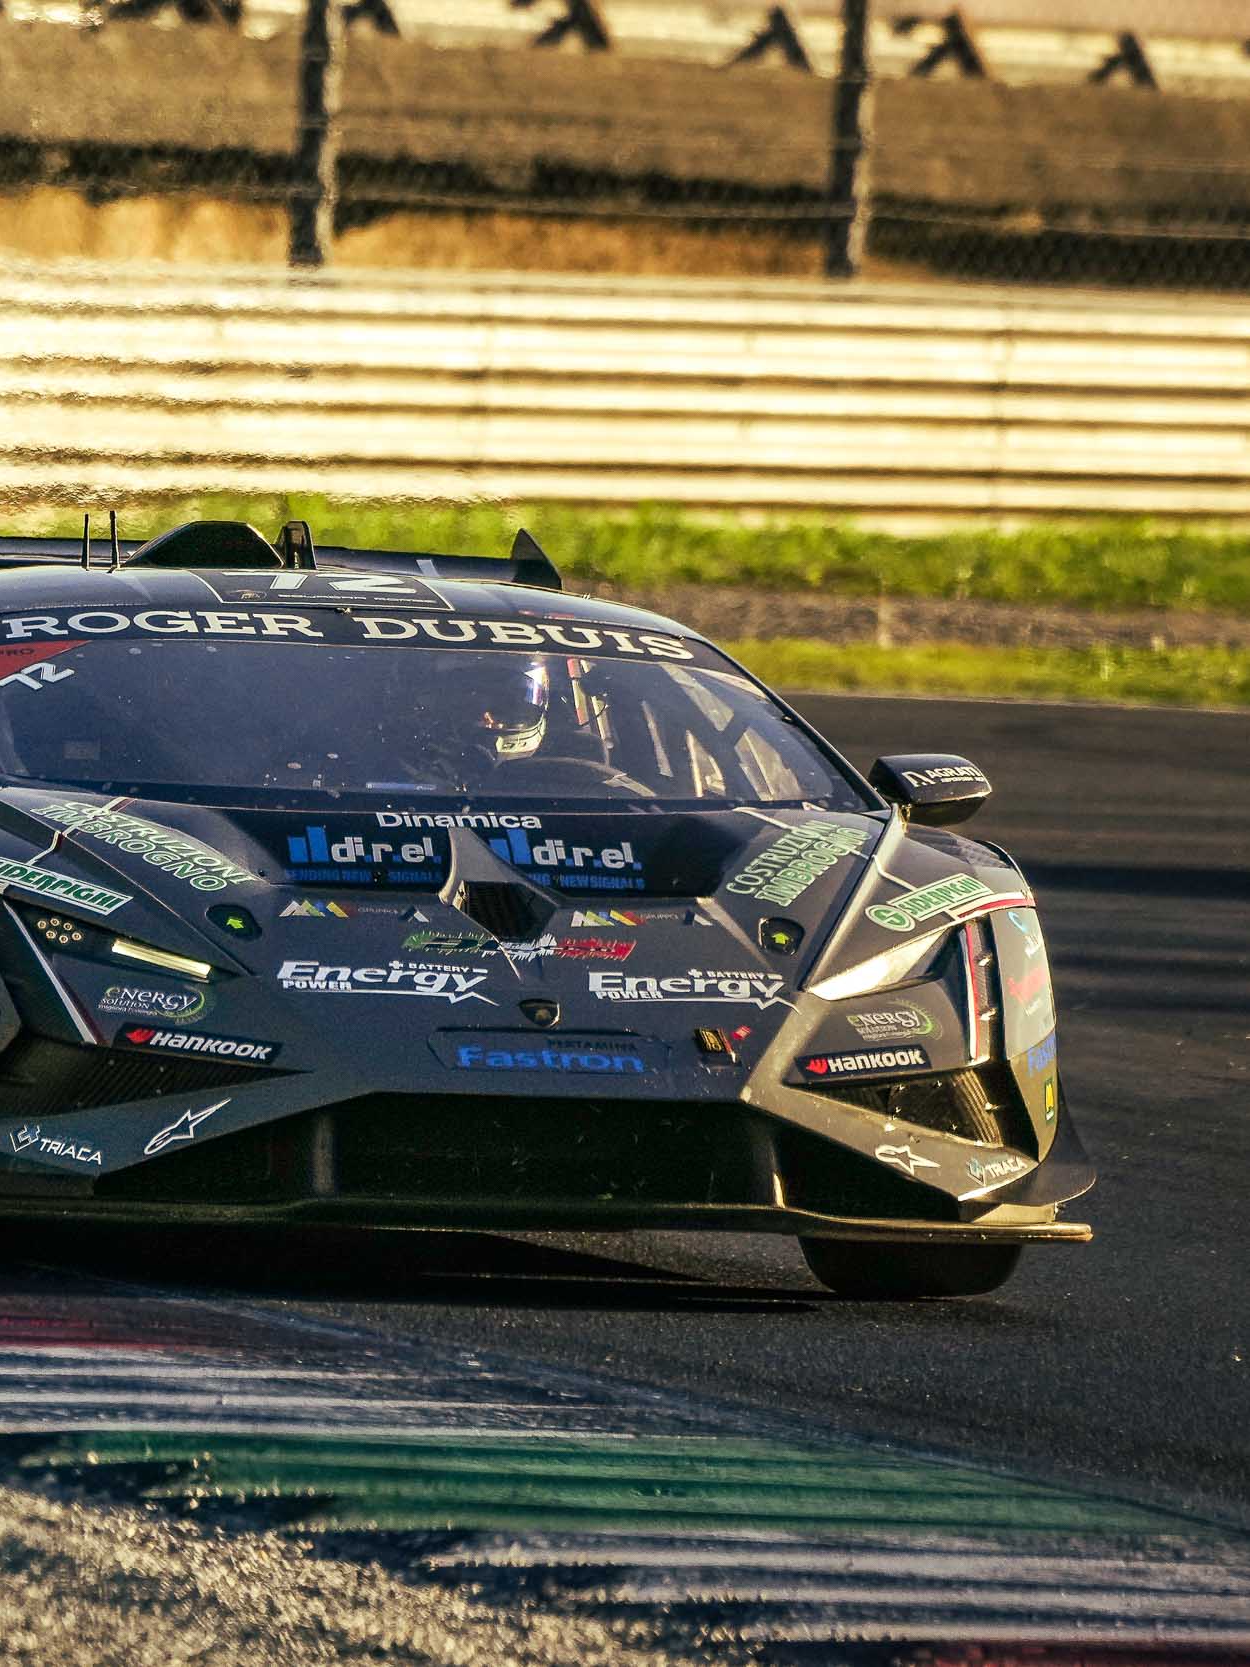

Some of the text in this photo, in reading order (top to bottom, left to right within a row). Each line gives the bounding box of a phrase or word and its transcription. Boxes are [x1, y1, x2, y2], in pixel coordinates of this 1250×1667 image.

[2, 610, 694, 660] ROGER DUBUIS
[925, 766, 983, 780] AGRATI
[376, 811, 543, 830] Dinamica
[30, 804, 227, 892] IMBROGNO
[66, 802, 254, 884] COSTRUZIONI
[277, 960, 488, 993] Energy
[407, 963, 470, 973] BATTERY
[706, 970, 764, 980] BATTERY
[282, 980, 352, 991] POWER
[589, 971, 785, 999] Energy
[596, 989, 664, 1000] POWER
[458, 1045, 645, 1073] Fastron
[39, 1137, 103, 1165] TRIACA
